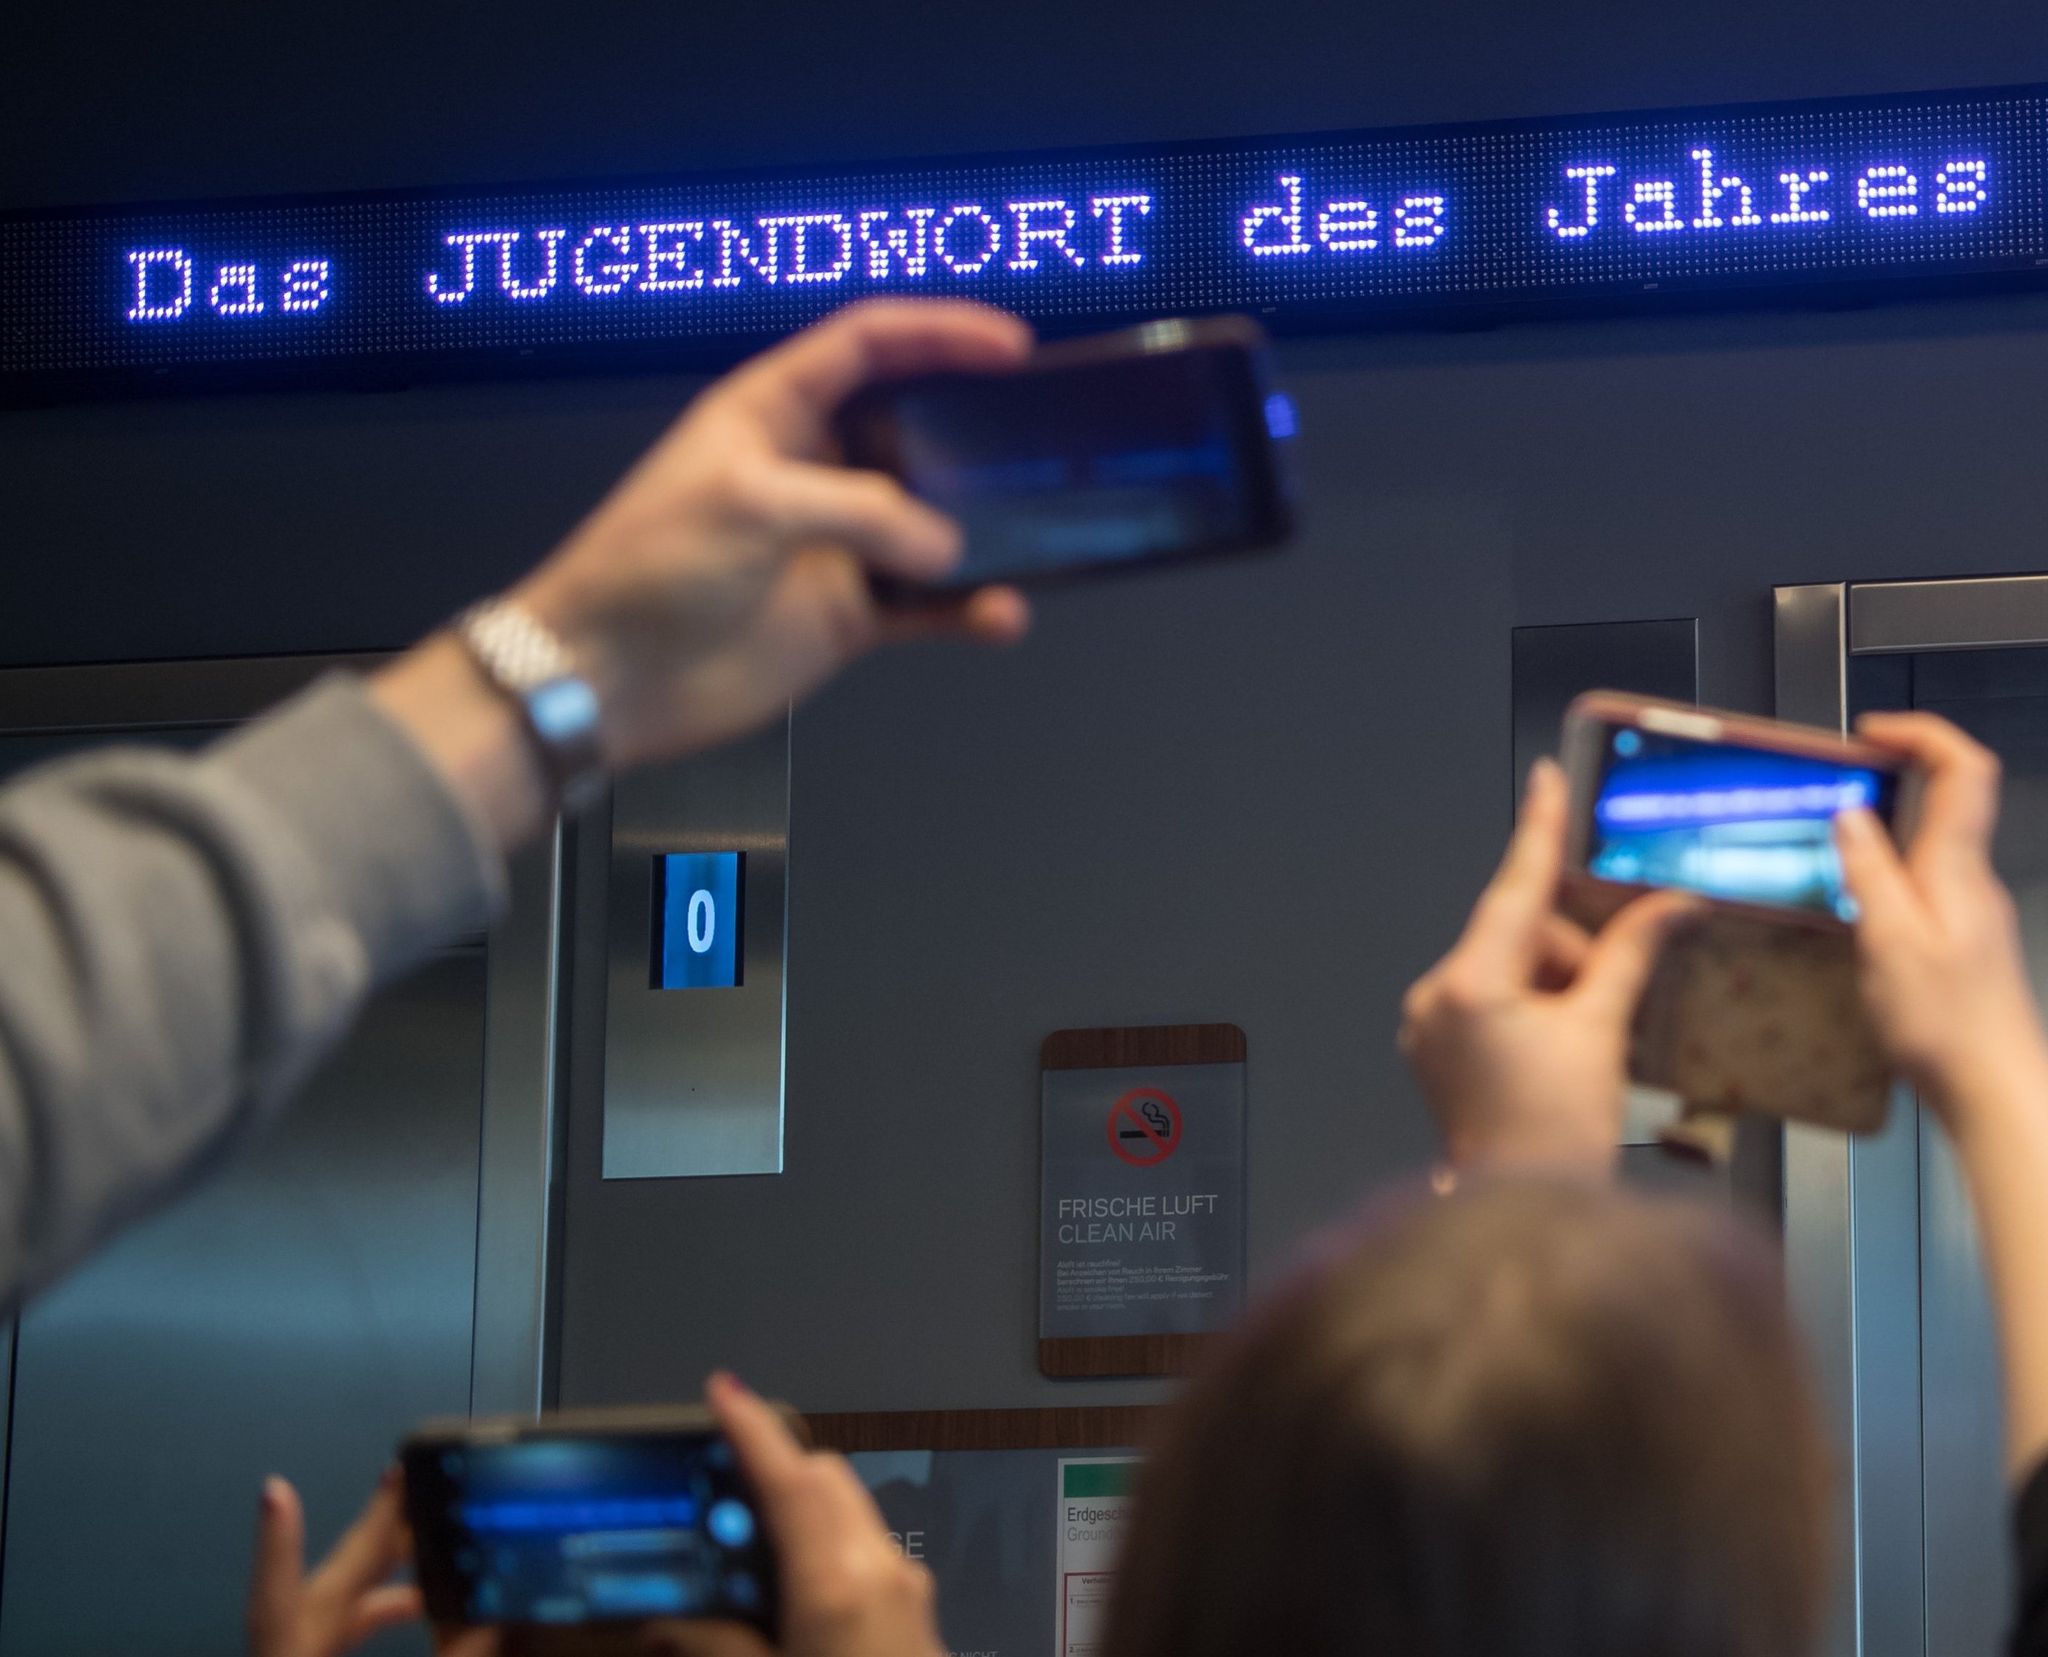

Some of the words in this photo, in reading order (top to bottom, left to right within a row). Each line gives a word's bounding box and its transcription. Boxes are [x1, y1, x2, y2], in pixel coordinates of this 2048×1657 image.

[128, 249, 329, 321] Das
[428, 195, 1151, 303] JUGENDWORT
[1241, 175, 1446, 256] des
[1546, 148, 1988, 238] Jahres
[688, 889, 715, 953] 0
[1058, 1196, 1156, 1219] FRISCHE
[1162, 1194, 1218, 1215] LUFT
[1058, 1222, 1133, 1244] CLEAN
[1139, 1220, 1176, 1241] AIR
[1067, 1507, 1129, 1525] Erdgesch
